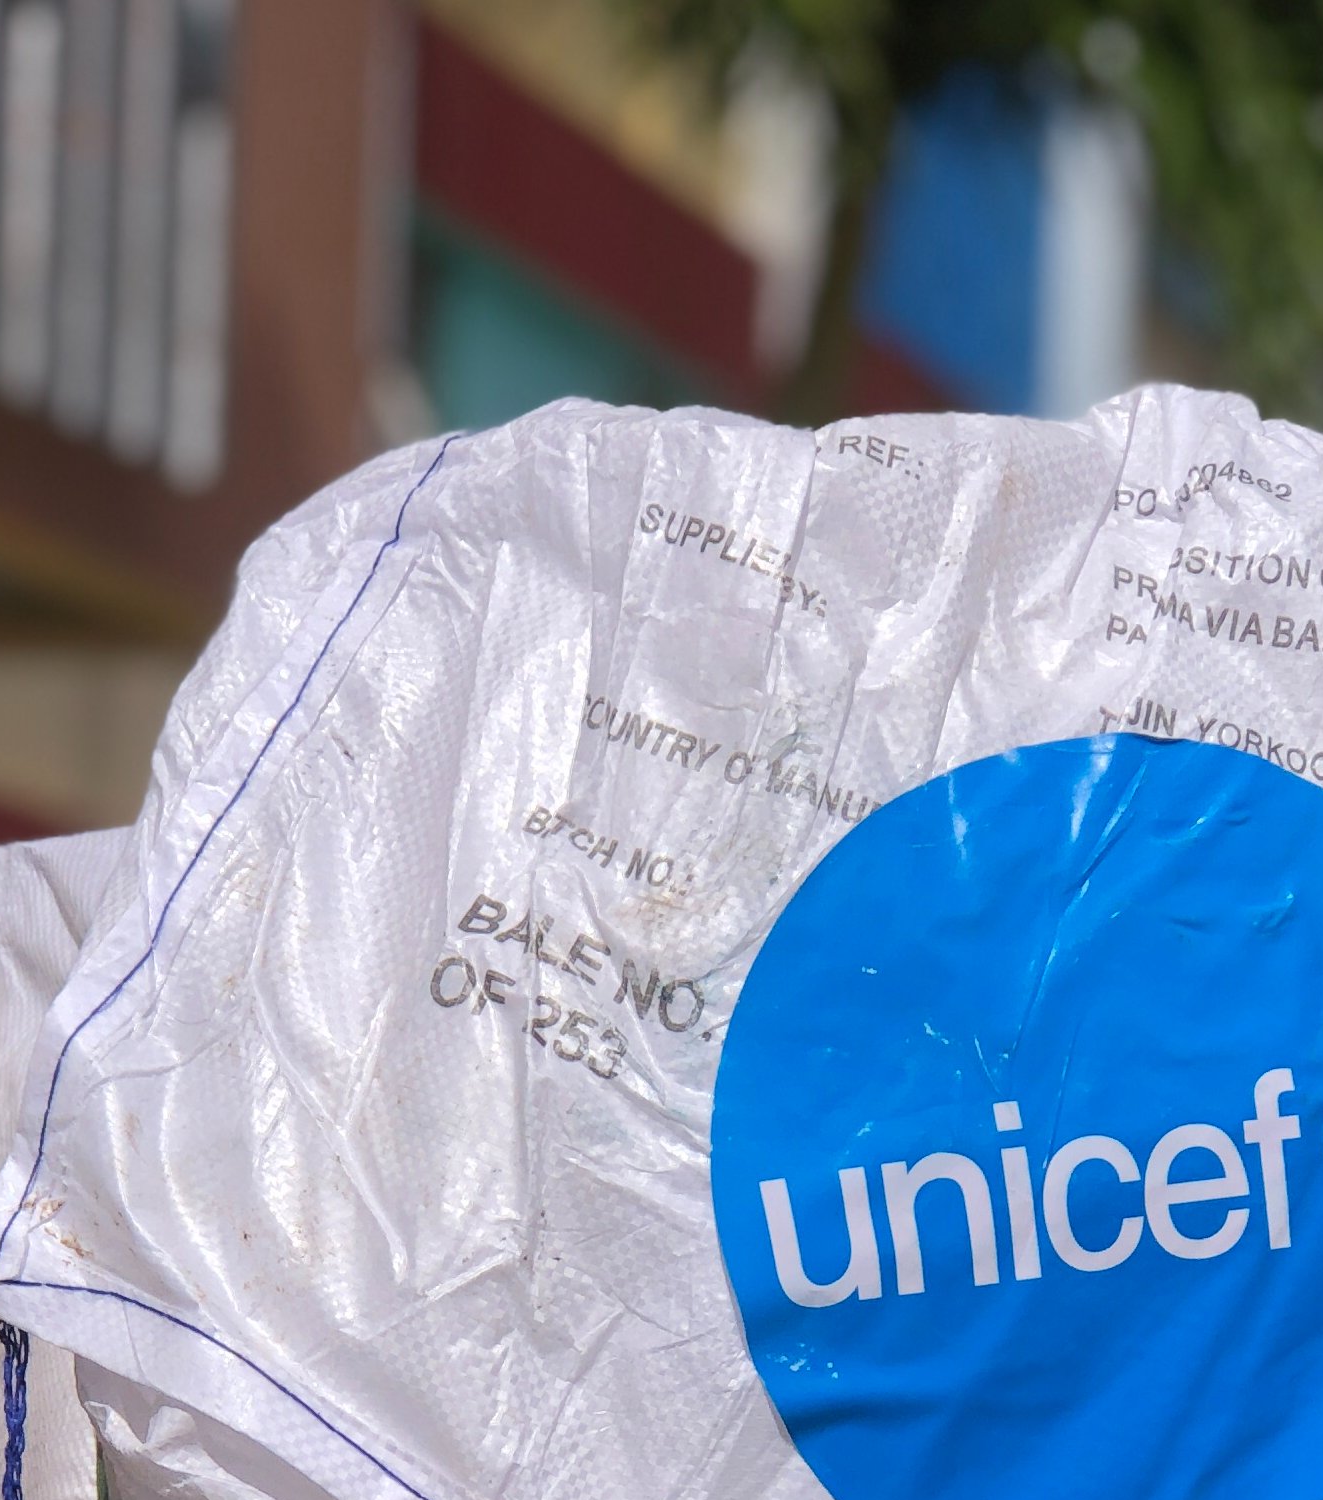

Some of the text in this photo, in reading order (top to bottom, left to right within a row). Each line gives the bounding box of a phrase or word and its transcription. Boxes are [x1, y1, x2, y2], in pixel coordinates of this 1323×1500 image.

[838, 435, 924, 481] REF.:
[1206, 604, 1264, 646] VIA
[582, 693, 723, 772] OUNTRY
[764, 757, 883, 824] MANU
[459, 894, 612, 985] BALE
[429, 956, 517, 1017] OF
[759, 1067, 1303, 1309] unicef
